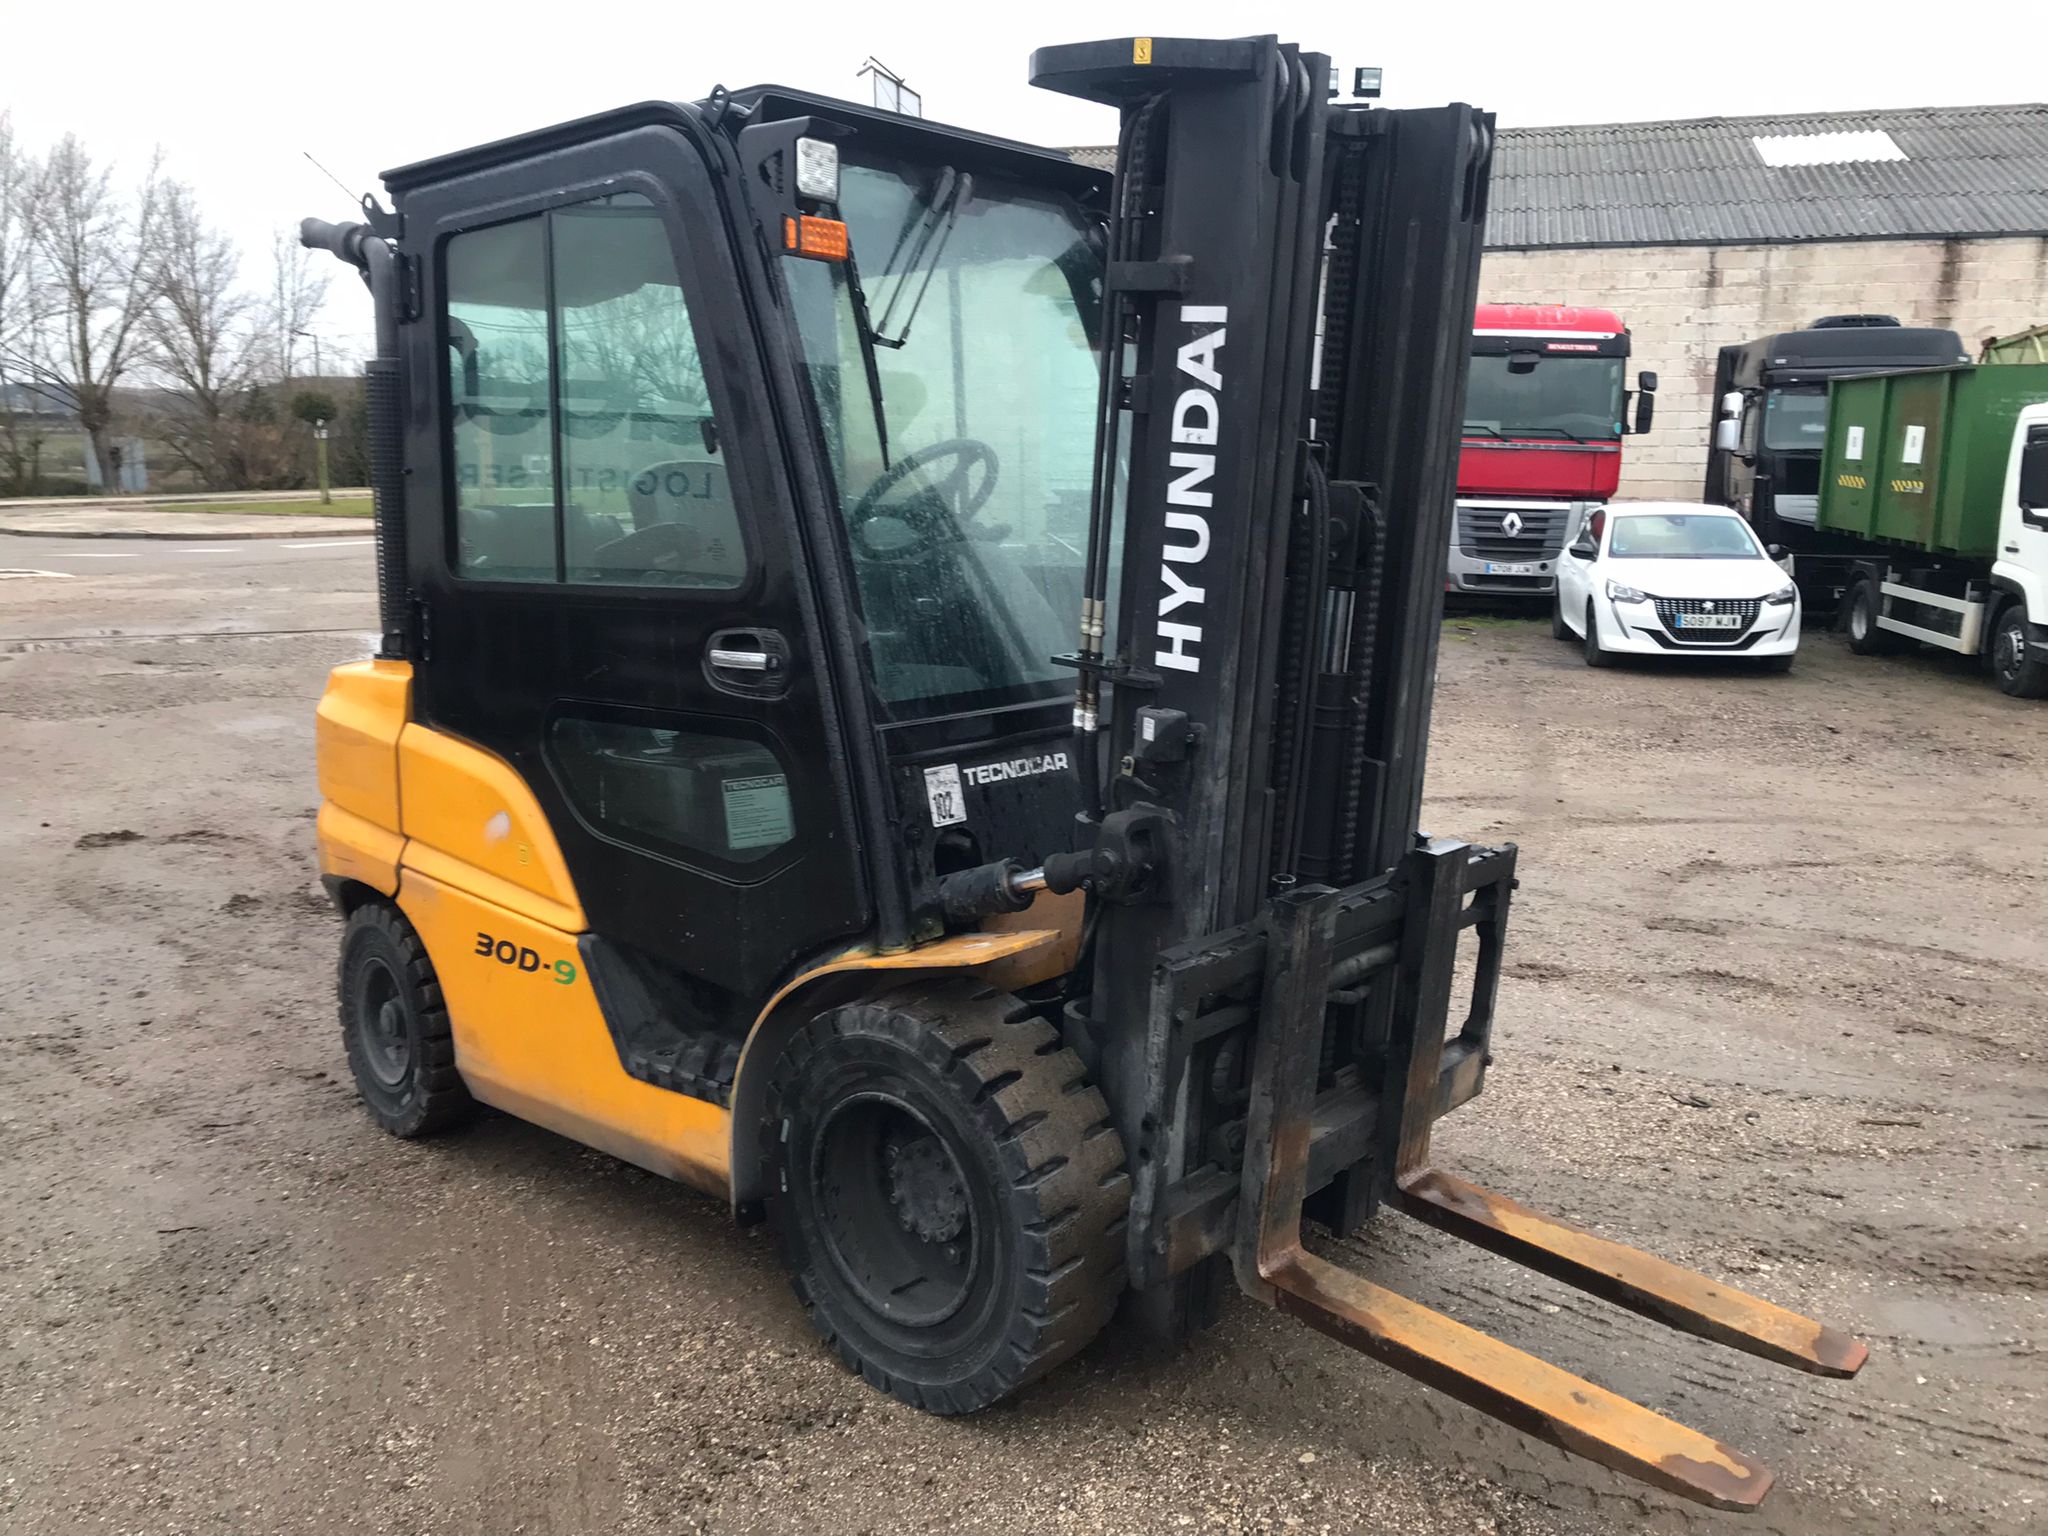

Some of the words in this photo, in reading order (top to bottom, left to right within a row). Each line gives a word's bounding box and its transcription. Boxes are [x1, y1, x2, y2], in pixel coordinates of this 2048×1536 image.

[1155, 306, 1228, 673] HYUNDAI
[962, 752, 1068, 786] TECNOCAR
[474, 931, 577, 985] 30D-9
